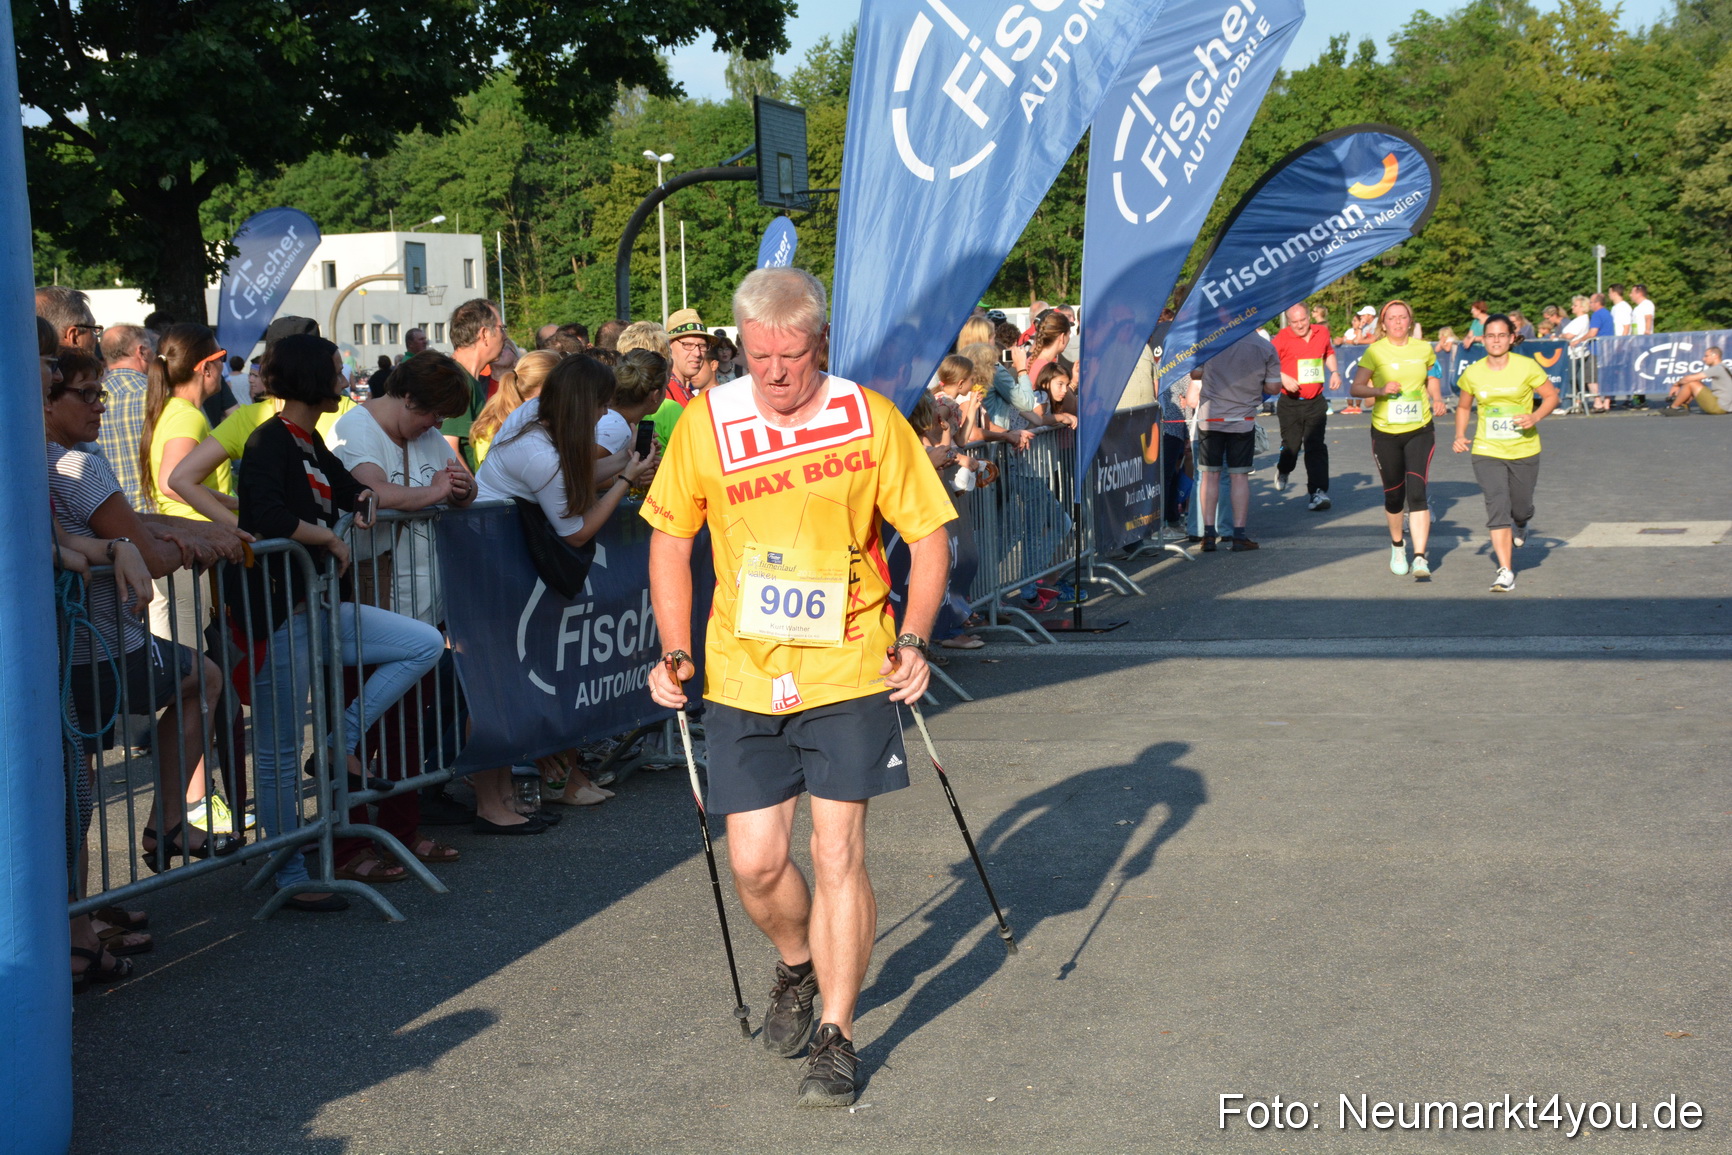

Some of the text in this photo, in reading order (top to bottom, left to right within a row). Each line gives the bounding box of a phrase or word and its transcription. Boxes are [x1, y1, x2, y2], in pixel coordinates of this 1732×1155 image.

[1182, 15, 1271, 184] AUTOMOBILE
[1306, 188, 1424, 264] Druck und Medien
[242, 225, 299, 306] Fischer
[262, 239, 306, 304] AUTOMOBILE
[1201, 203, 1366, 309] Frischmann
[1303, 368, 1320, 377] 250
[1395, 403, 1418, 415] 644
[726, 449, 877, 506] MAX BÖGL
[747, 569, 777, 582] walken
[758, 560, 798, 573] firmenlauf
[556, 588, 662, 672] Fisch
[760, 585, 826, 619] 906
[785, 624, 811, 633] Walther
